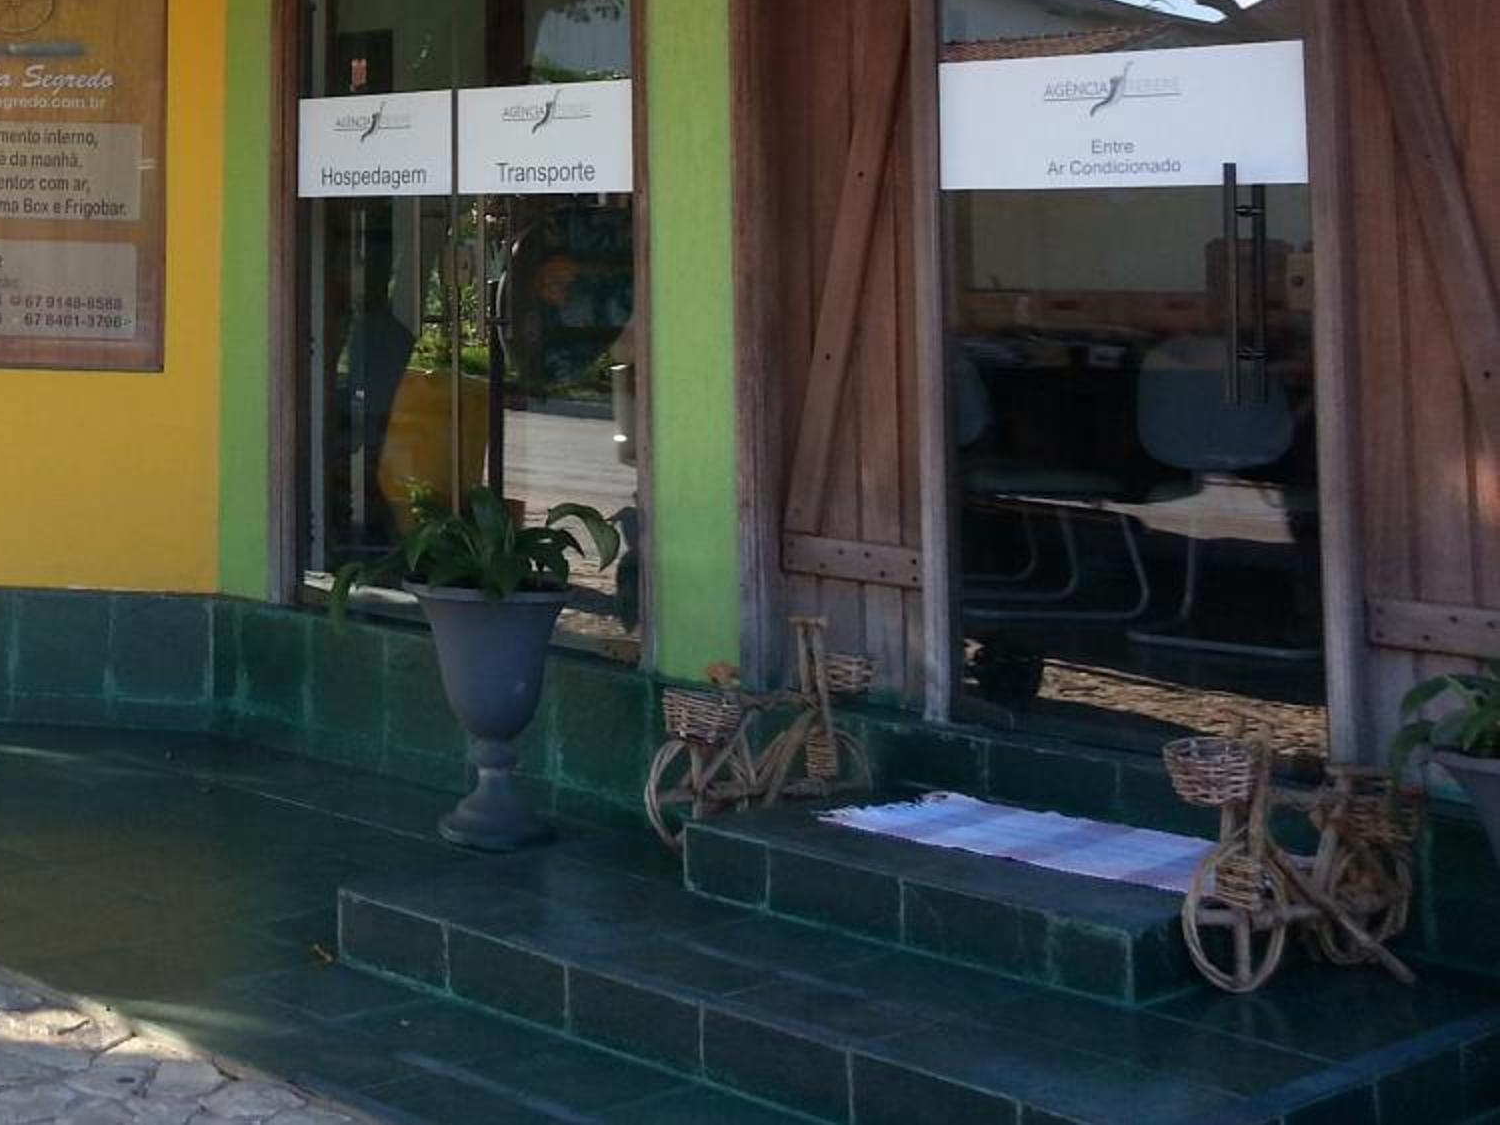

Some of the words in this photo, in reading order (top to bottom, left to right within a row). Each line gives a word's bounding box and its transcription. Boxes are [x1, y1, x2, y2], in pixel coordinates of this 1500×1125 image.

[21, 63, 116, 96] Segredo
[1090, 138, 1135, 155] Entre
[9, 151, 27, 167] da
[1046, 160, 1067, 176] Ar
[1068, 158, 1182, 176] Condicionado
[320, 164, 427, 189] Hospedagem
[496, 161, 596, 184] Transporte
[39, 176, 70, 191] com
[23, 197, 50, 214] Box
